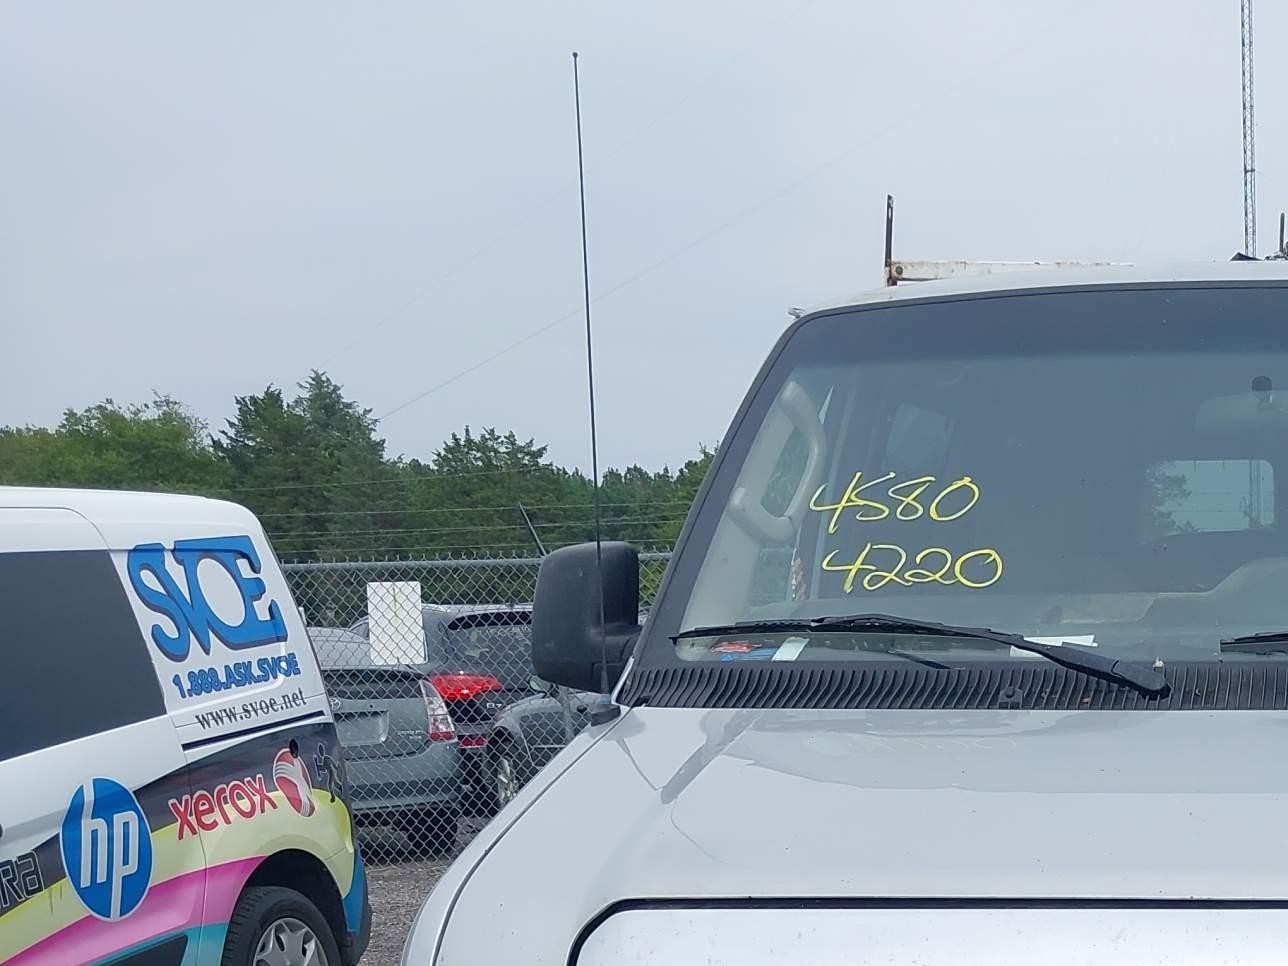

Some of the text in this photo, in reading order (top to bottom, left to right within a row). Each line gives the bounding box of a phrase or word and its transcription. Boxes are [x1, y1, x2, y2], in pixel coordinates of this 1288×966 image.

[810, 472, 981, 535] 4580
[127, 535, 289, 663] SVOE
[822, 543, 1004, 593] 4220
[172, 652, 301, 699] 1.888.ASK.SVOE
[194, 687, 308, 731] www.svoe.net
[168, 773, 279, 842] xerox
[79, 782, 141, 922] hp
